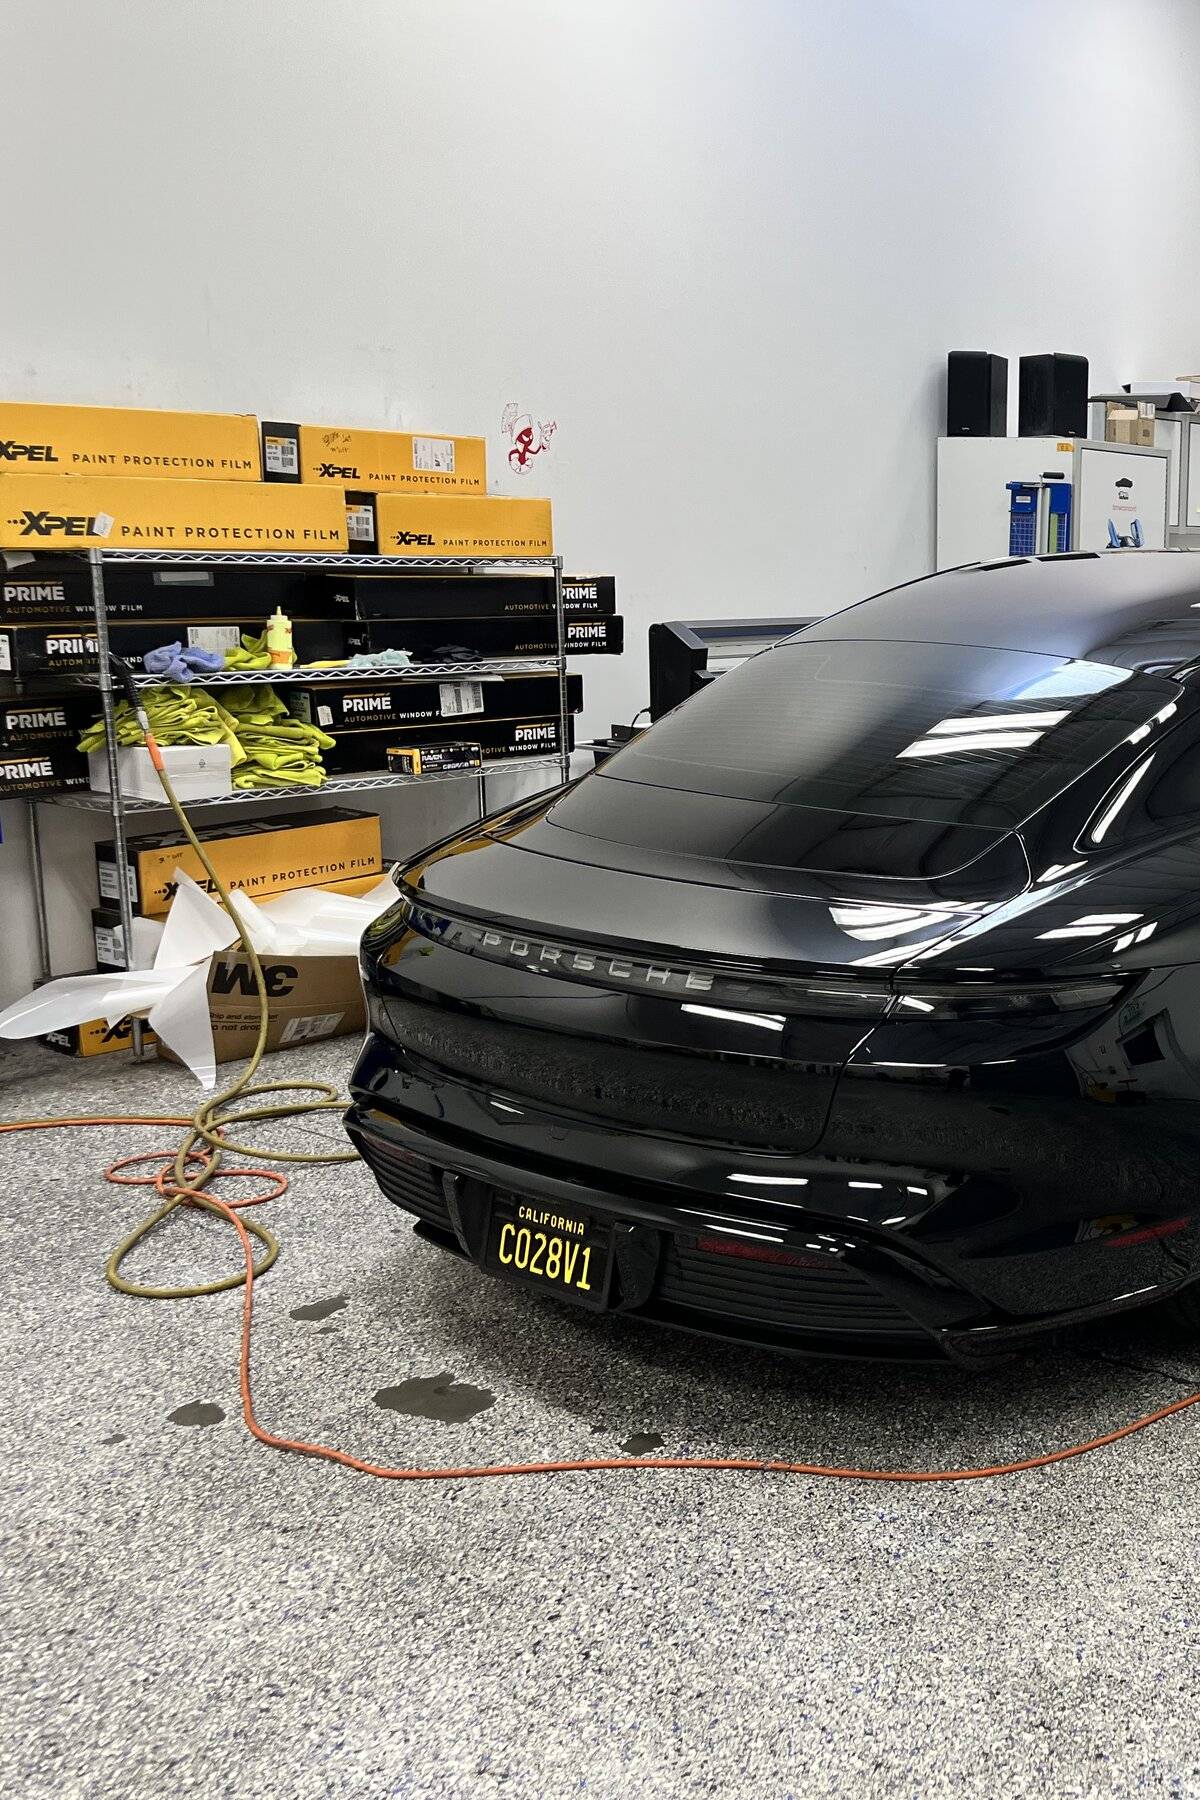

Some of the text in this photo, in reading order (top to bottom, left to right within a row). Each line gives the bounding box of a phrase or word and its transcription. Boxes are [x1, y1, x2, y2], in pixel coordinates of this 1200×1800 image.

[0, 441, 252, 469] XPEL PAINT PROTECTION FILM
[319, 463, 480, 486] XPEL PAINT PROTECTION FILM
[19, 511, 339, 540] XPEL PAINT PROTECTION FILM
[396, 531, 435, 546] XPEL
[473, 539, 526, 547] PROTECTION
[4, 586, 65, 601] PRIME
[6, 605, 71, 614] AUTOMOTIVE
[121, 604, 143, 612] FILM
[504, 603, 549, 611] AUTOMOTIVE
[567, 626, 606, 639] PRIME
[343, 697, 392, 713] PRIME
[6, 711, 67, 730] PRIME
[344, 713, 396, 723] AUTOMOTIVE
[400, 711, 432, 719] WINDOW
[515, 727, 556, 741] PRIME
[481, 746, 506, 754] MOTIVE
[509, 743, 538, 752] WINDOW
[65, 776, 90, 785] WIND
[163, 878, 220, 901] XEL
[230, 876, 266, 889] PAINT
[272, 862, 346, 882] PROTECTION
[350, 856, 375, 868] FILM
[483, 931, 714, 991] PORSCHE
[518, 1206, 585, 1236] CALIFORNIA
